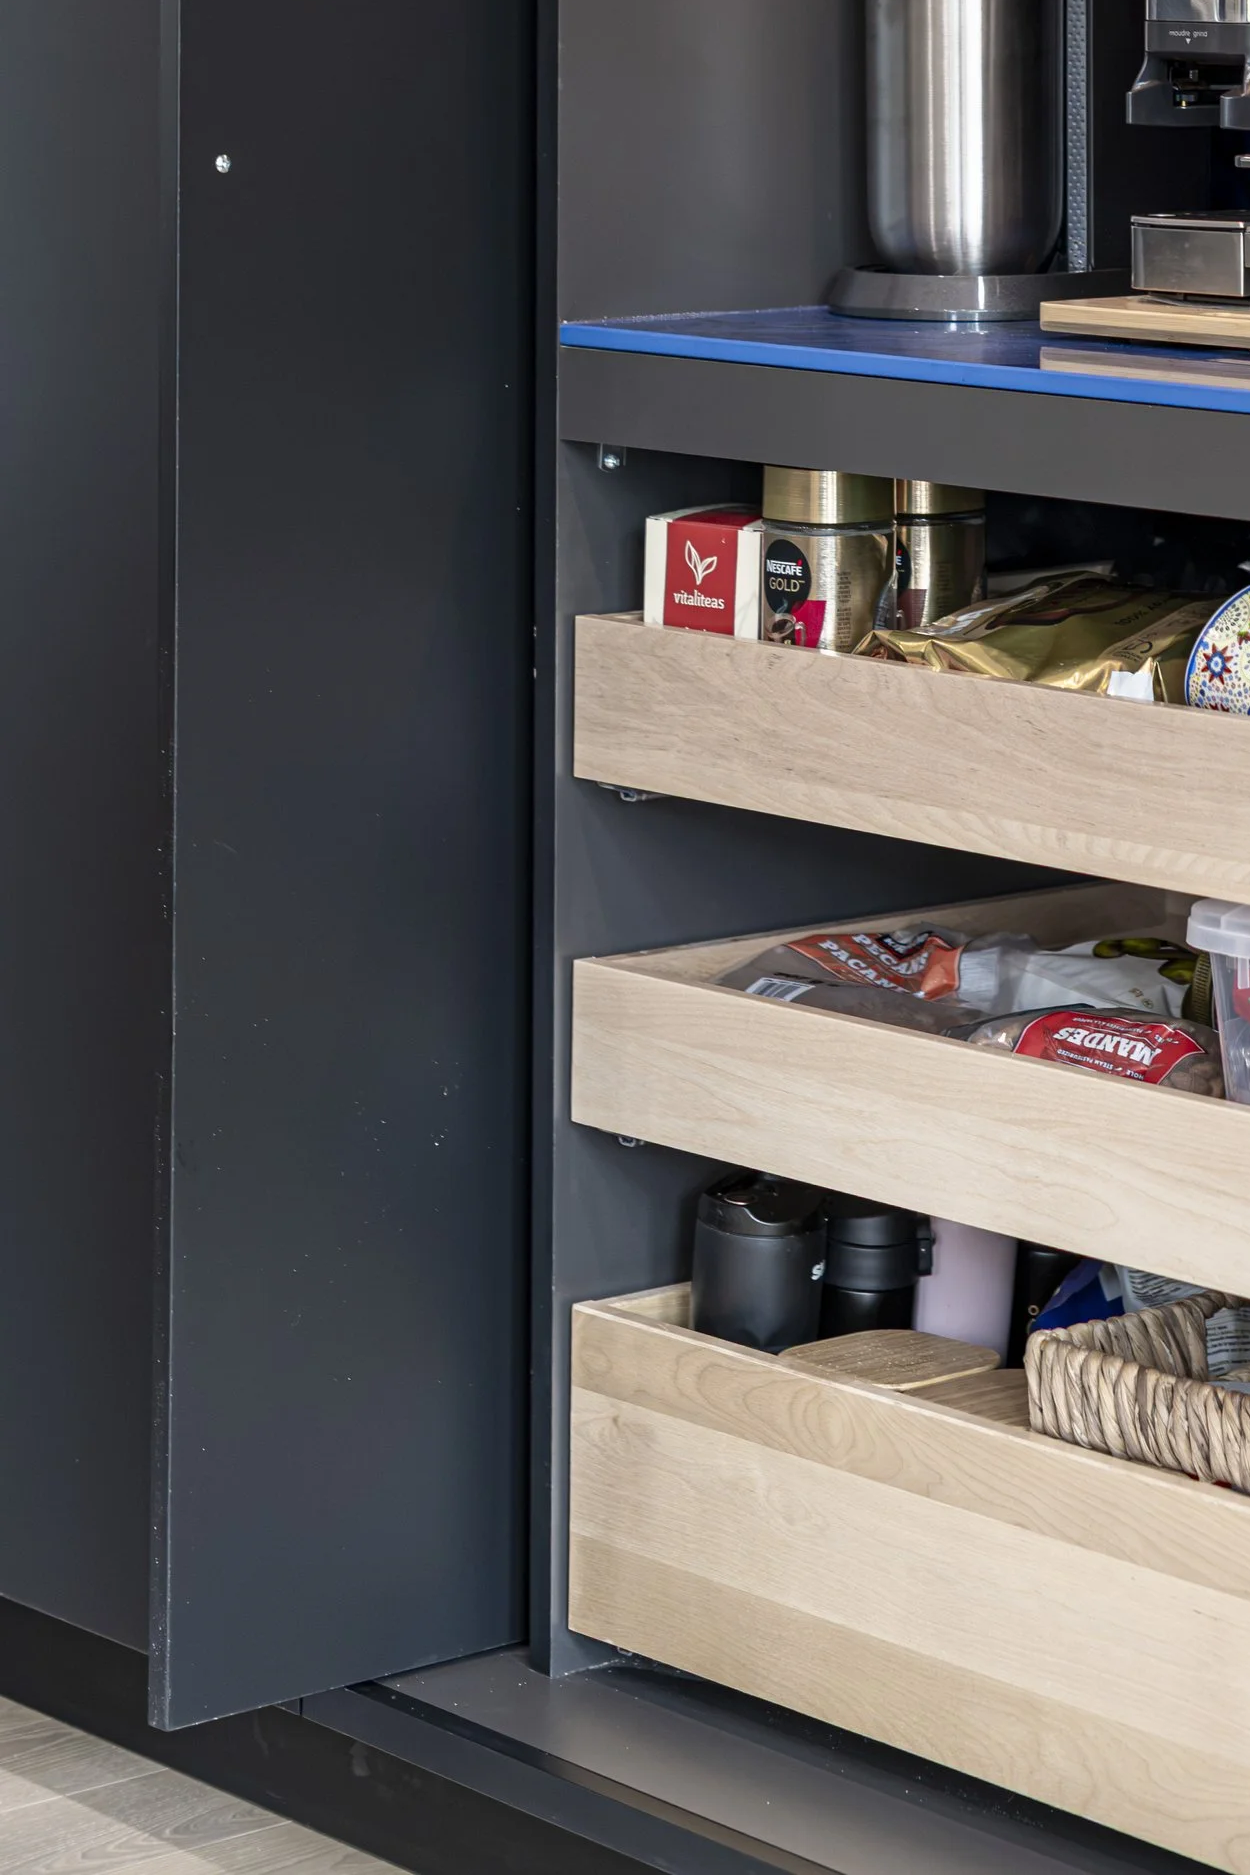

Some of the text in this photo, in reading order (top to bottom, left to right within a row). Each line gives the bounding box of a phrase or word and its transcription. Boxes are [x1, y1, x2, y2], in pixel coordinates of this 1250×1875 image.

[769, 577, 800, 593] GOLD
[673, 589, 725, 610] vitaliteas
[1094, 1059, 1114, 1071] STEAM
